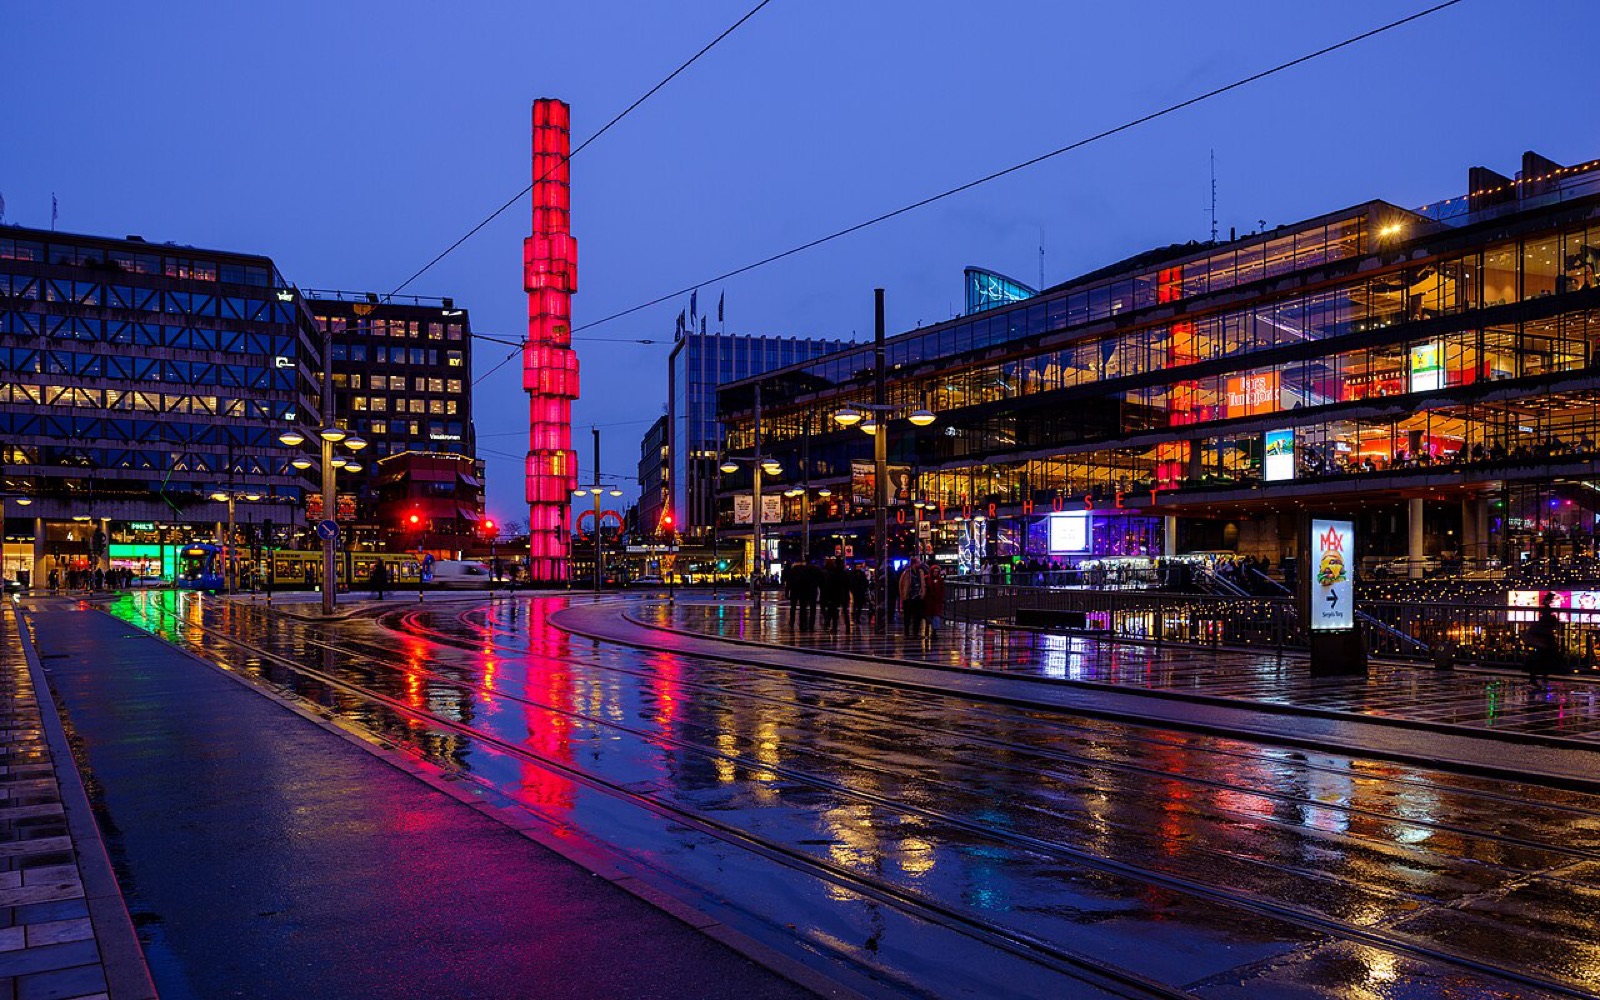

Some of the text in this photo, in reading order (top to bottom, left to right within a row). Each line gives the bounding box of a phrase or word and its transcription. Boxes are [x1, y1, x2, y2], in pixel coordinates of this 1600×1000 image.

[1239, 376, 1266, 391] Lars
[896, 489, 1159, 524] ULTURHUSET
[1320, 525, 1344, 551] MAX
